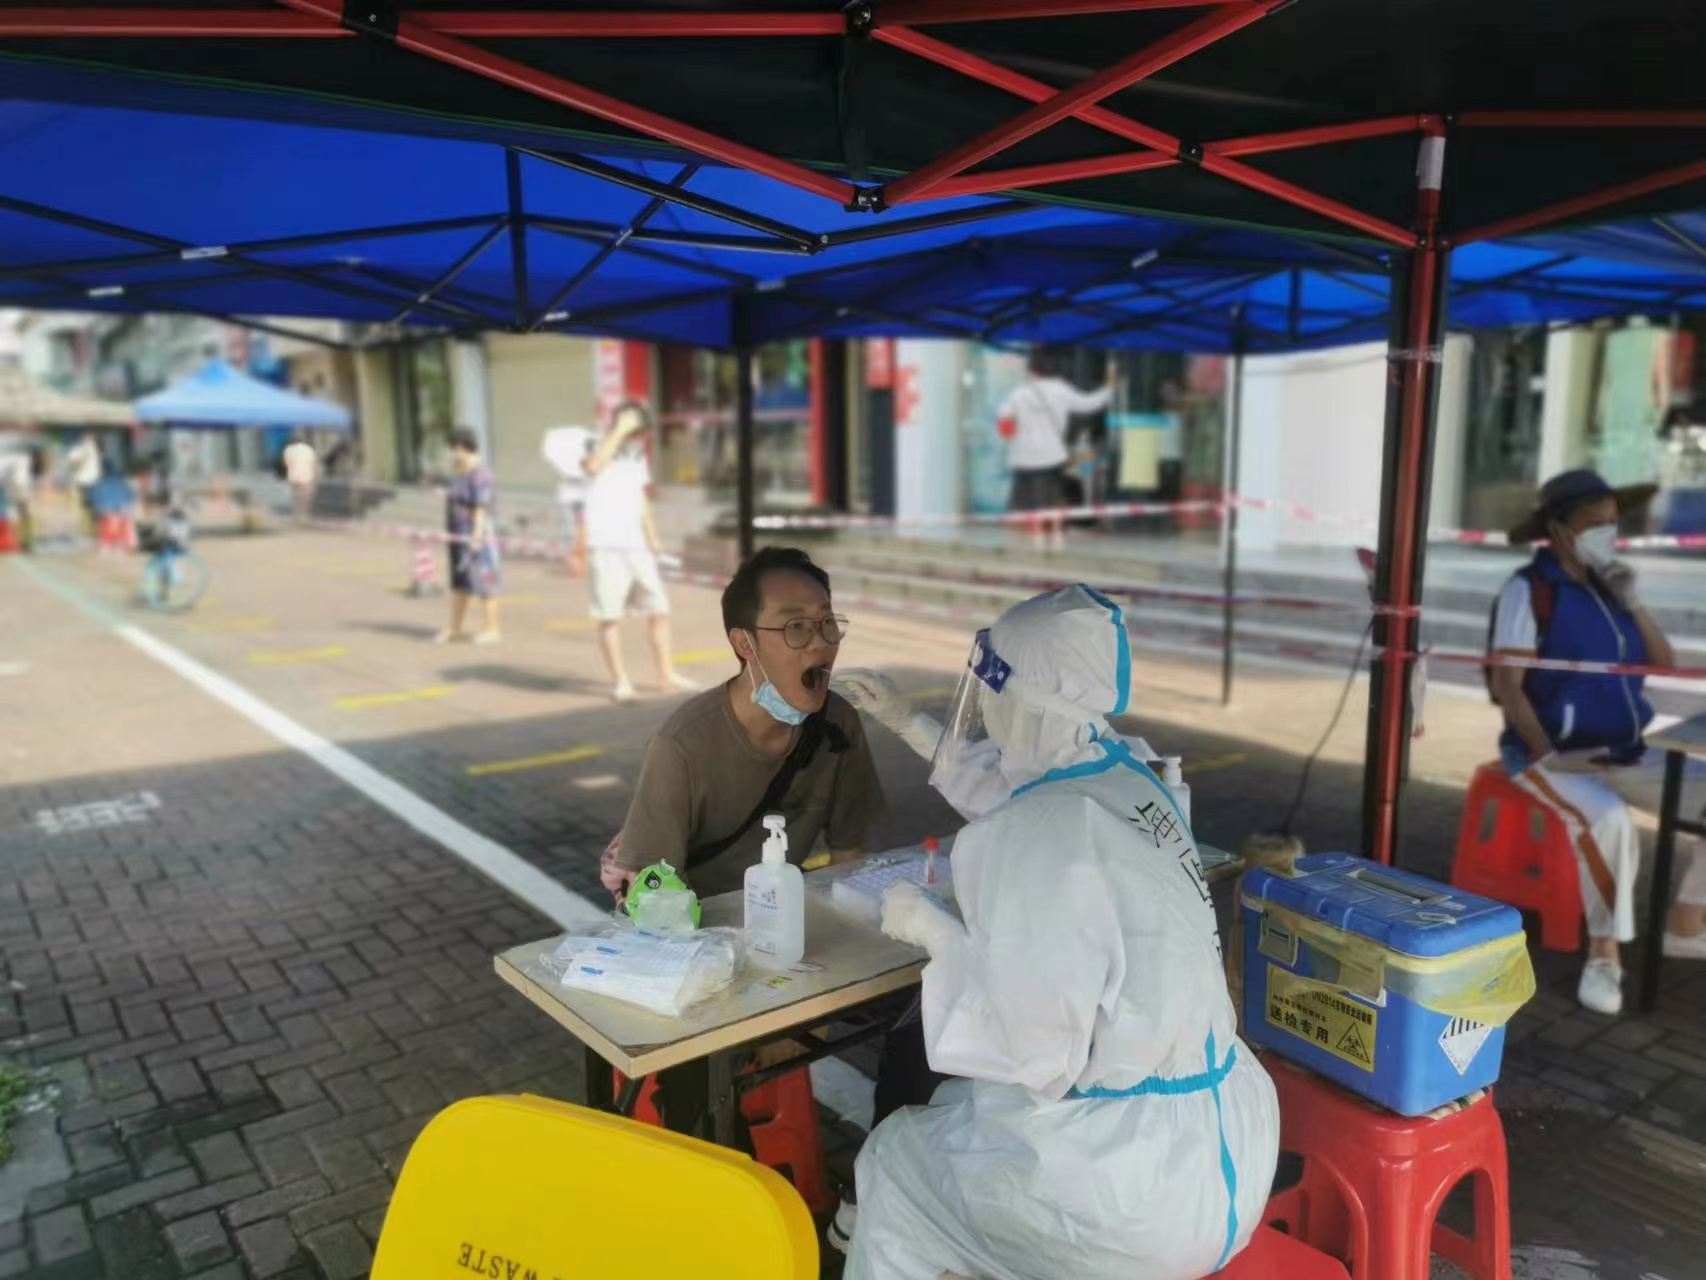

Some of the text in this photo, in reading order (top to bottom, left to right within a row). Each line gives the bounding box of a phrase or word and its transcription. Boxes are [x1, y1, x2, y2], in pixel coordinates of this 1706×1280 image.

[1270, 1004, 1329, 1044] 送检专用
[456, 1242, 538, 1280] WASTE
